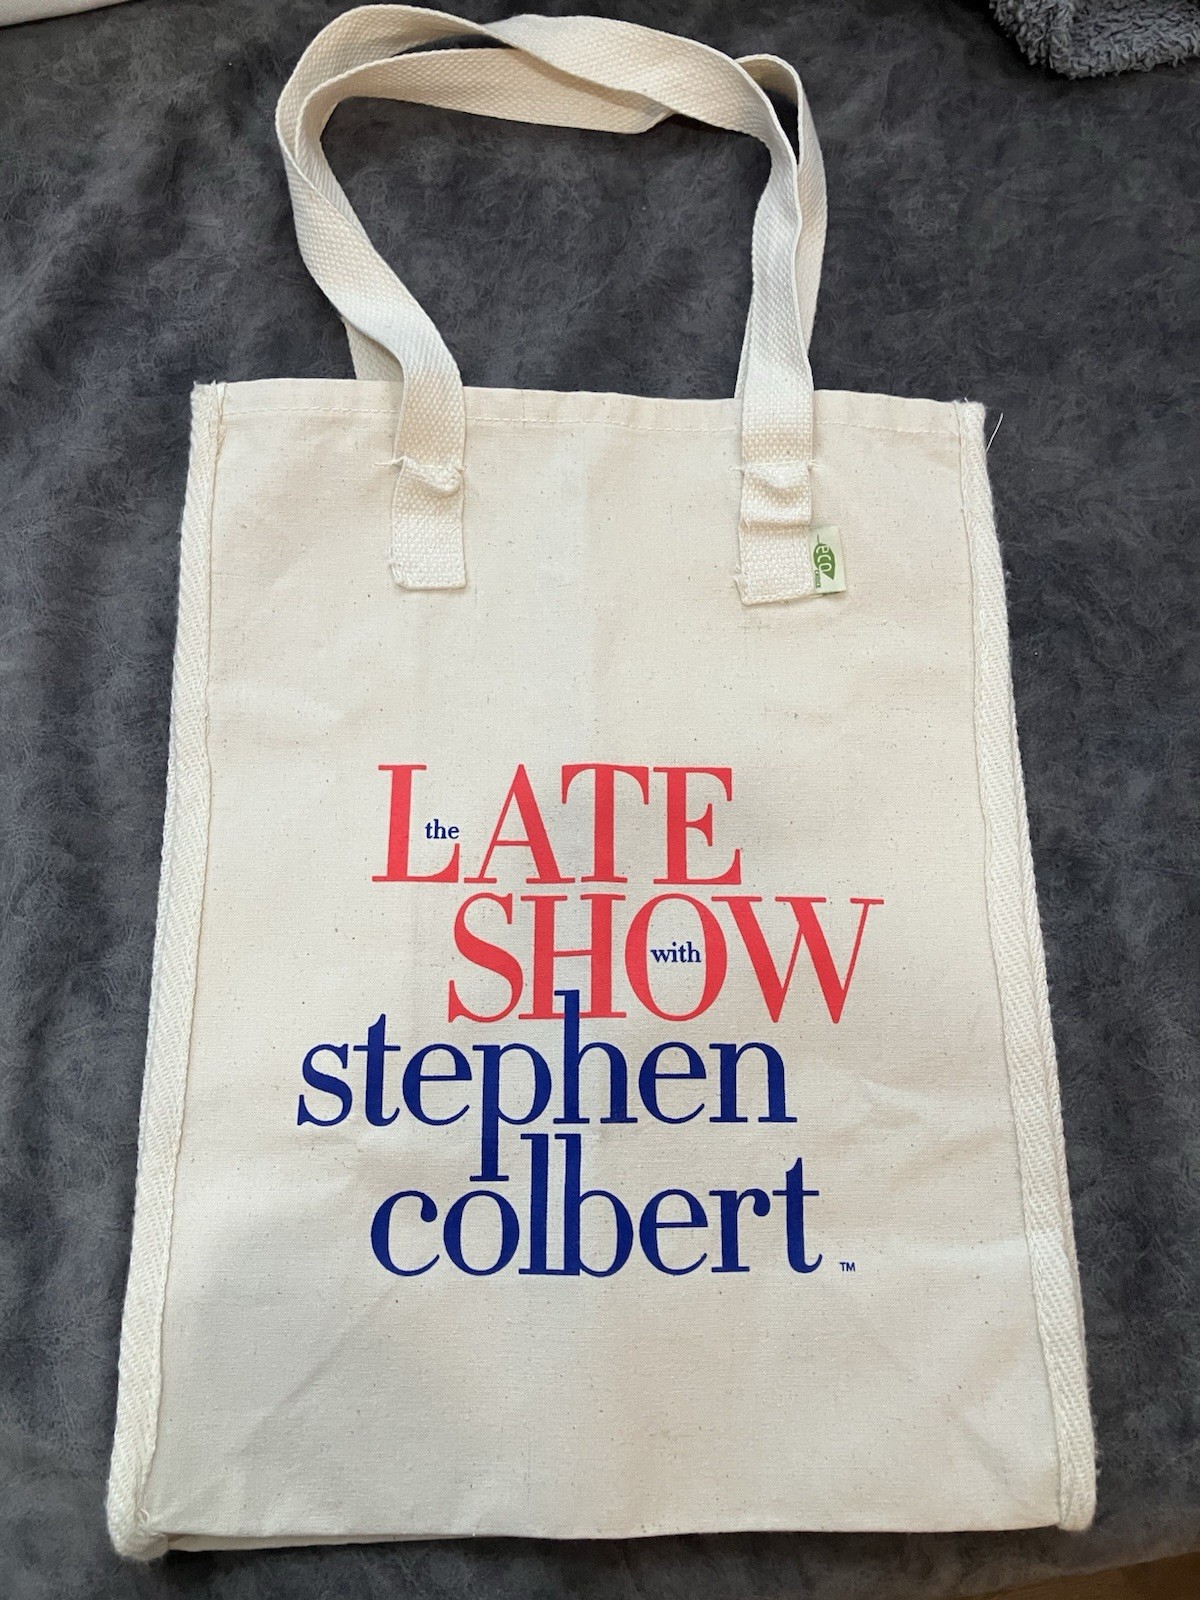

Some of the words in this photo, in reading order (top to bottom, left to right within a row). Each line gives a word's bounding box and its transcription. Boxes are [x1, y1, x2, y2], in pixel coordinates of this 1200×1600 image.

[815, 545, 832, 572] eco
[372, 764, 741, 884] LATE
[425, 818, 460, 839] the
[447, 893, 884, 1023] SHOW
[650, 942, 701, 963] with
[297, 990, 798, 1181] stephen
[371, 1133, 823, 1277] colbert
